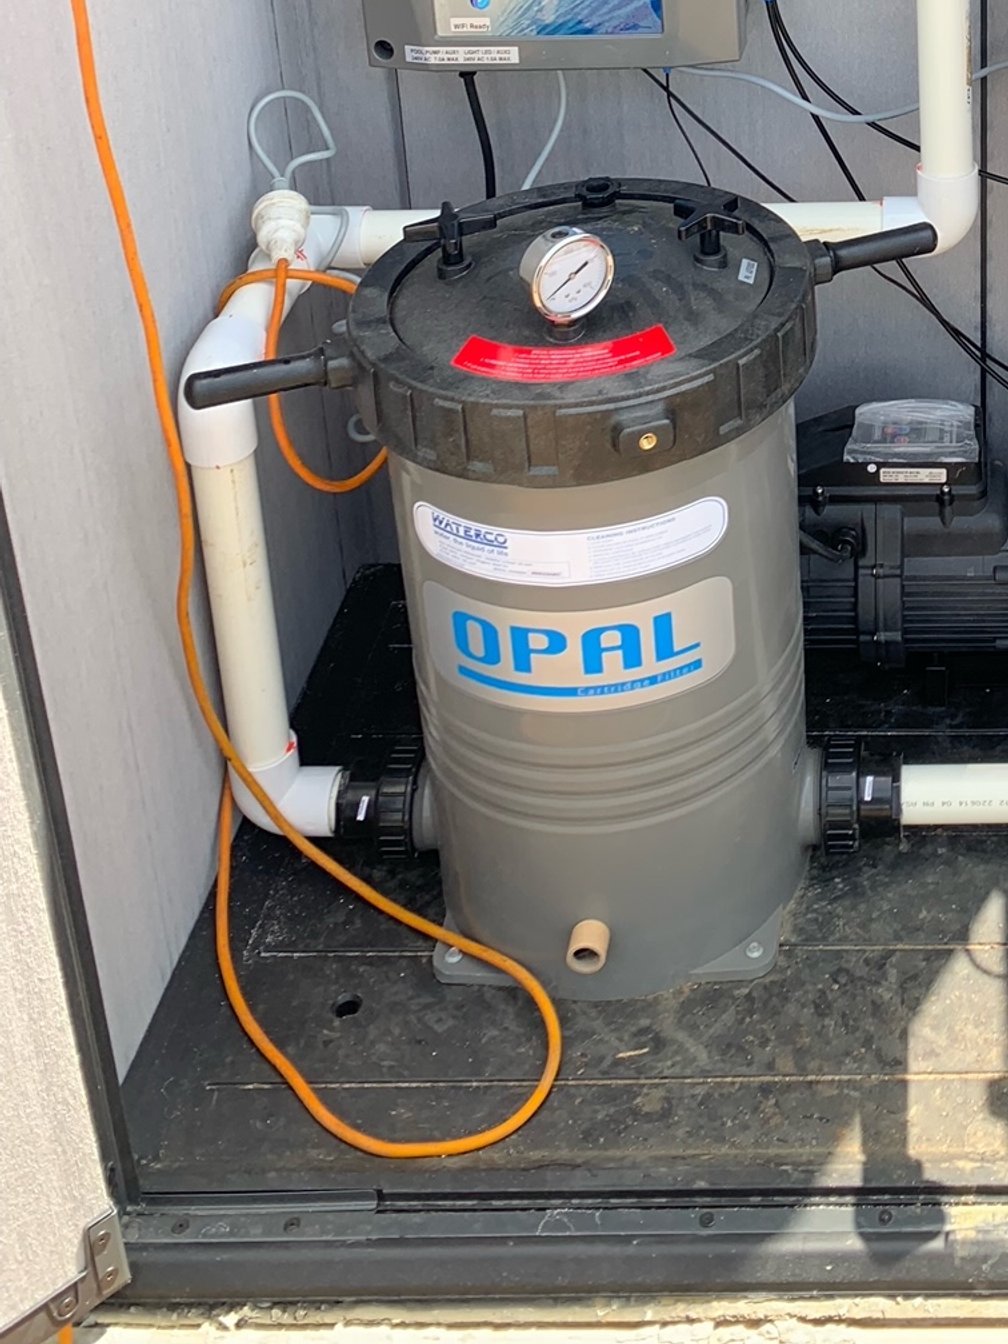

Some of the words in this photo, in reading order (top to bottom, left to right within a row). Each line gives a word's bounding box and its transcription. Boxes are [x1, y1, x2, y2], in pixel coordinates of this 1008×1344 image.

[470, 23, 489, 31] Ready
[432, 512, 508, 545] WATERCO
[587, 531, 623, 541] CLEANING
[625, 517, 676, 534] INSTRUCTIONS
[452, 610, 701, 675] OPAL
[577, 678, 650, 696] Cartridge
[657, 664, 695, 684] Filter
